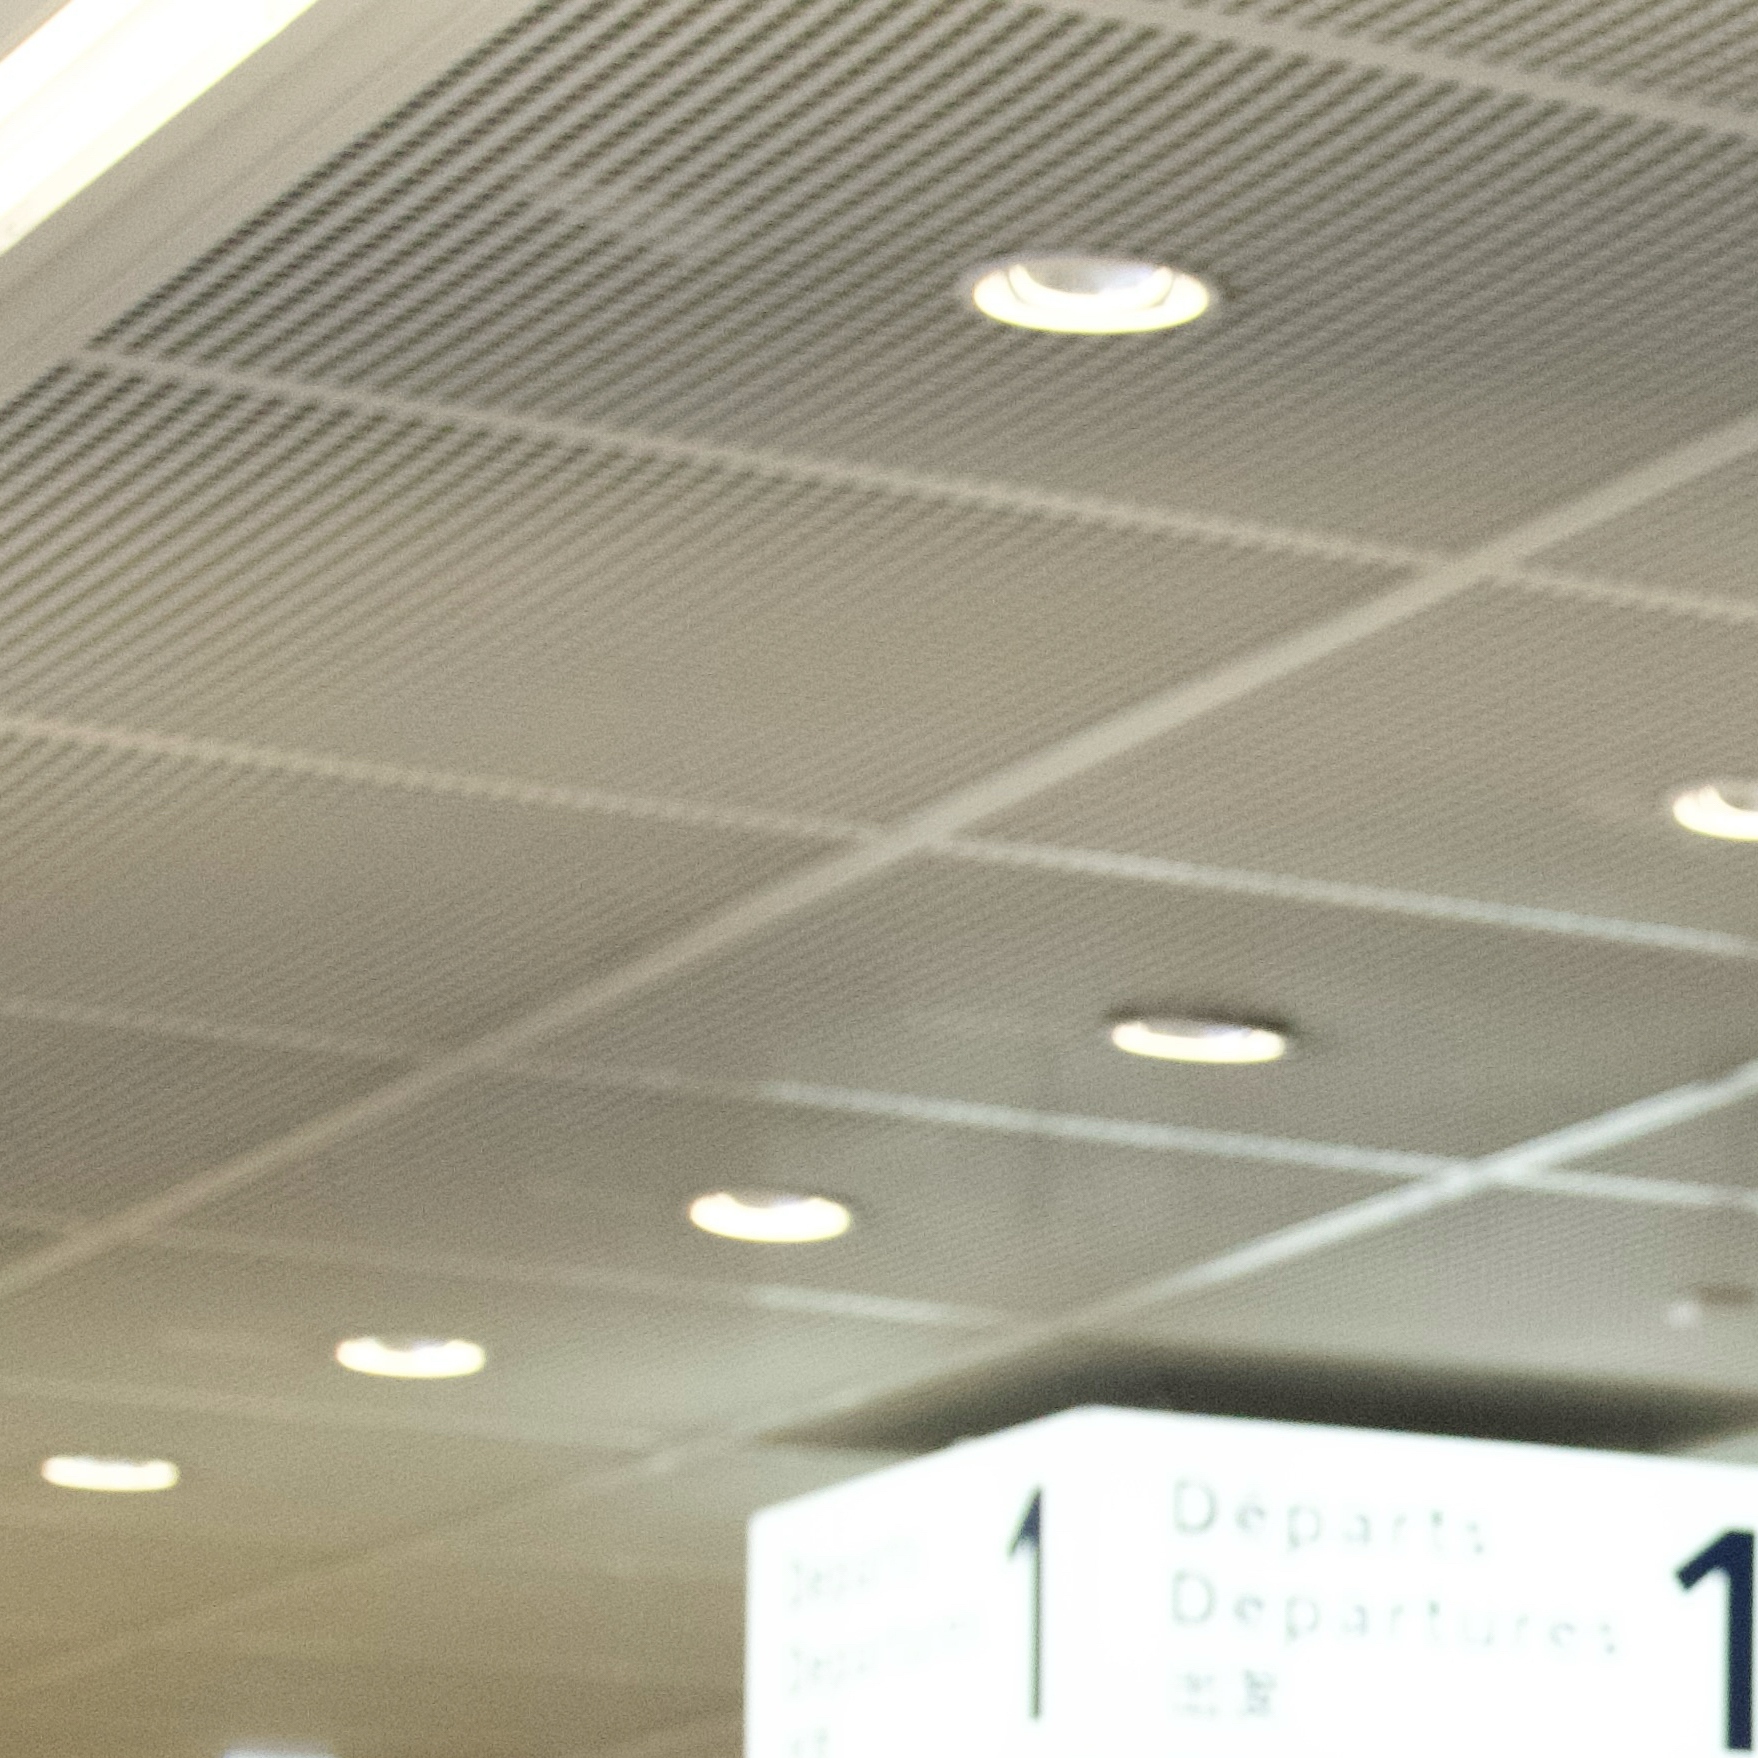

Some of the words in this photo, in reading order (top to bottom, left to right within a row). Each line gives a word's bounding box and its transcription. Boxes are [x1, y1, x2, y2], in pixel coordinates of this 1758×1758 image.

[1006, 1484, 1042, 1720] 1
[1170, 1568, 1619, 1654] Departures
[1675, 1528, 1754, 1752] 1
